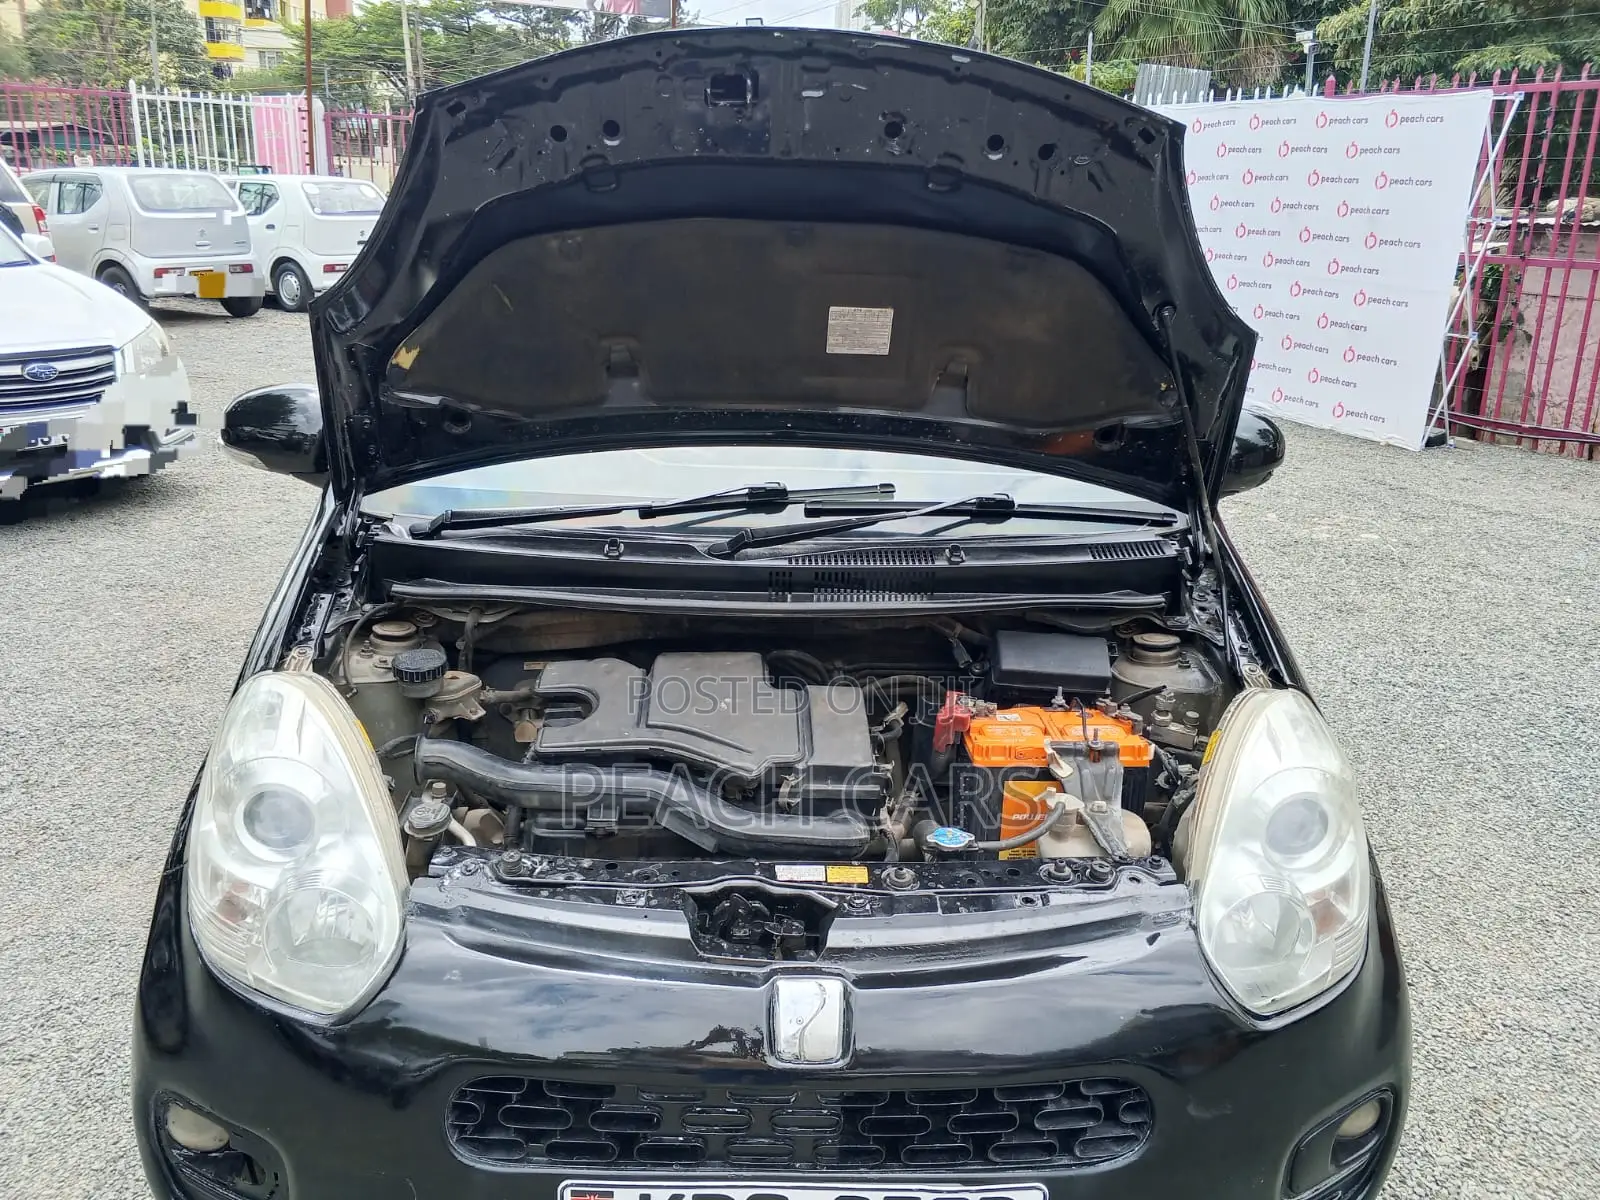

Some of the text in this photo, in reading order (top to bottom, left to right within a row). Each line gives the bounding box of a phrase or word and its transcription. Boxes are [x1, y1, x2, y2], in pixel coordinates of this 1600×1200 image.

[1261, 117, 1296, 128] peach cars
[1328, 116, 1350, 126] peach
[1400, 114, 1426, 125] peach
[1203, 120, 1221, 132] peach
[1228, 146, 1247, 156] peach
[1291, 144, 1311, 155] peach
[1359, 146, 1382, 156] peach
[1197, 173, 1215, 182] peach
[1254, 173, 1274, 183] peach
[1320, 175, 1342, 184] peach
[1389, 176, 1432, 186] peach cars
[1220, 199, 1240, 208] peach
[1282, 200, 1302, 210] peach
[1350, 206, 1389, 215] peach cars
[1247, 228, 1266, 238] peach
[1312, 232, 1333, 242] peach
[1378, 238, 1402, 248] peach
[1214, 252, 1232, 260] peach
[1274, 256, 1294, 266] peach
[1340, 264, 1362, 274] peach
[1238, 280, 1257, 289] peach
[1302, 287, 1339, 298] peach cars
[1367, 295, 1408, 308] peach cars
[1264, 309, 1300, 320] peach cars
[1330, 320, 1367, 332] peach cars
[1293, 340, 1329, 354] peach cars
[1356, 353, 1397, 366] peach cars
[1257, 361, 1292, 374] peach cars
[1320, 374, 1357, 388] peach cars
[1284, 393, 1319, 408] peach cars
[1345, 408, 1385, 423] peach cars
